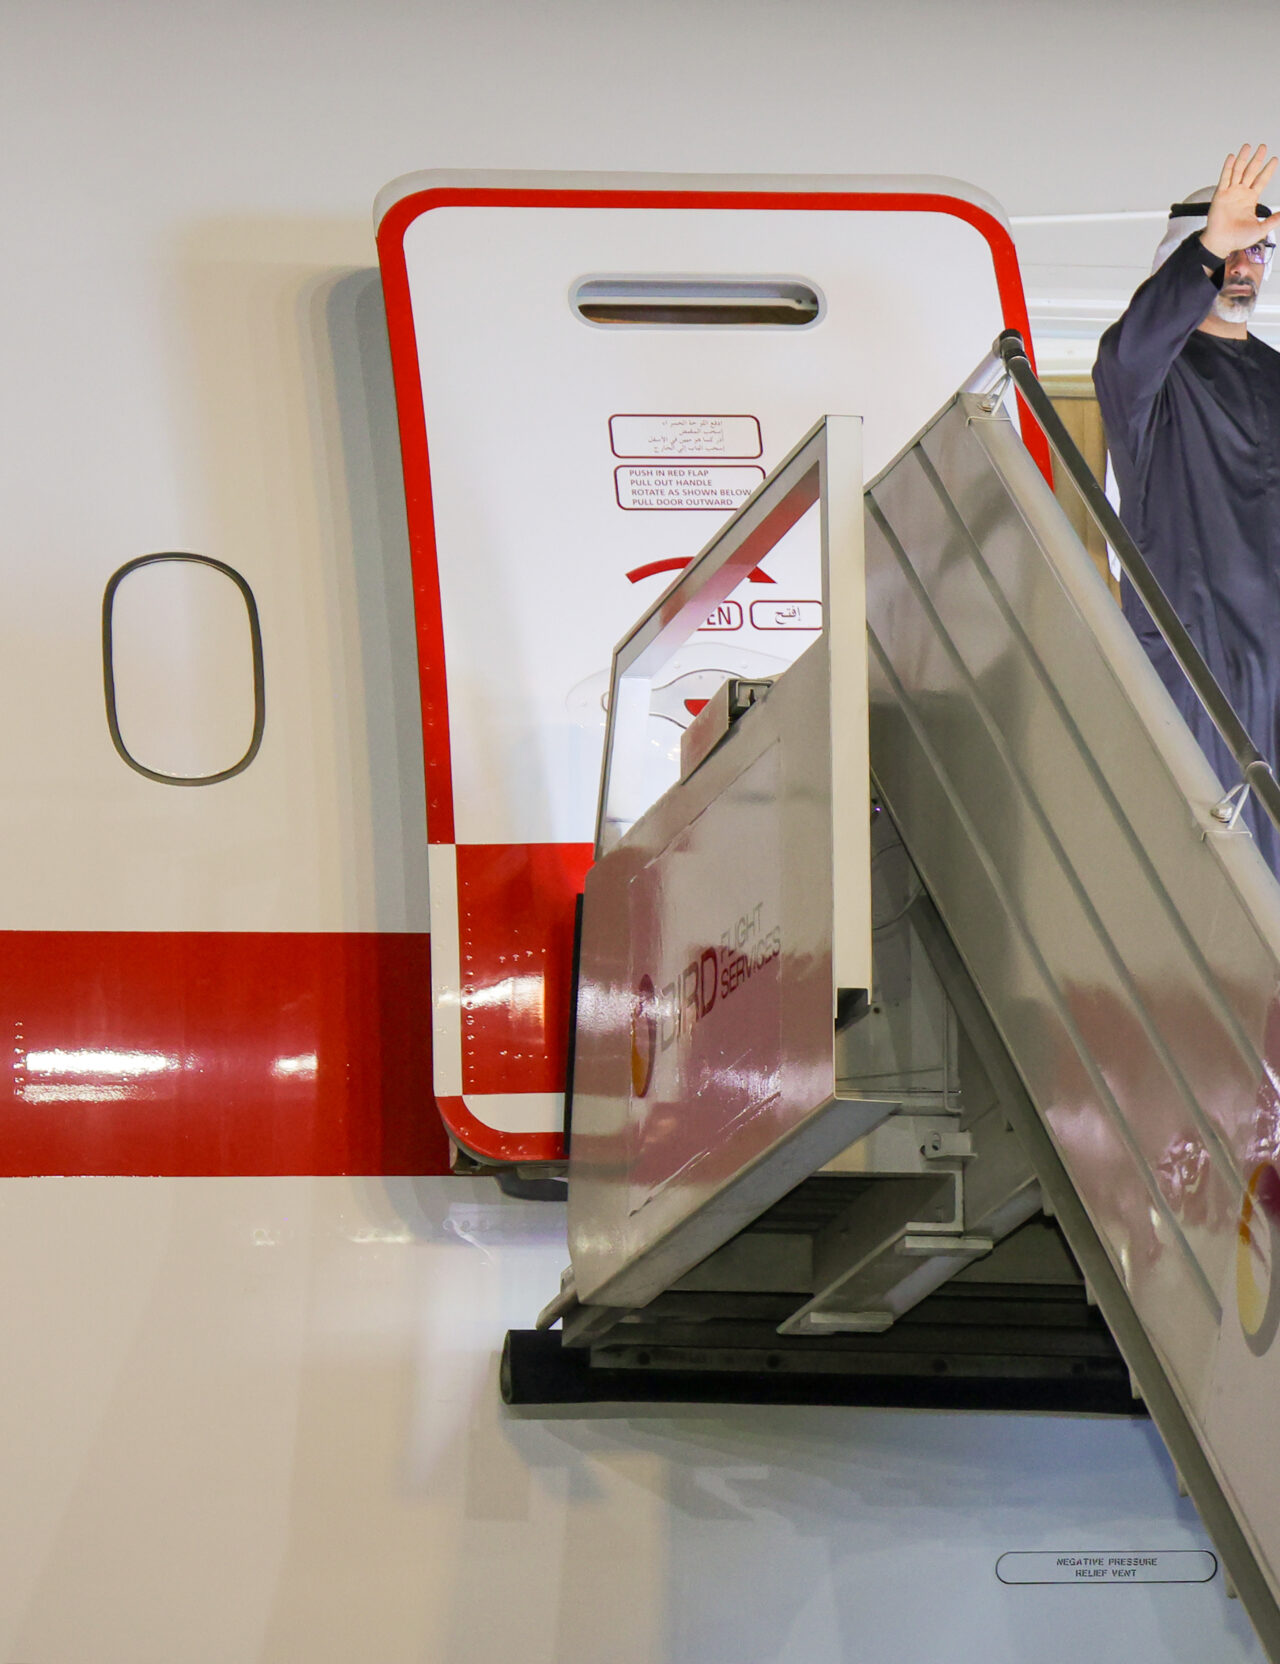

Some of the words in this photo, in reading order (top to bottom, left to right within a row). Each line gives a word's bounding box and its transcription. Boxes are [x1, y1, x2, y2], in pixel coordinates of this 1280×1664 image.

[629, 469, 653, 477] PUSH
[655, 469, 665, 477] IN
[667, 469, 685, 477] RED
[687, 469, 709, 477] FLAP
[632, 498, 654, 506] PULL
[656, 498, 683, 506] DOOR
[686, 498, 733, 506] OUTWARD
[706, 606, 732, 625] EN
[720, 902, 763, 963] FLIGHT
[720, 925, 781, 1000] SERVICES
[1056, 1557, 1105, 1566] NEGATIVE
[1108, 1557, 1158, 1566] PRESSURE
[1075, 1569, 1108, 1577] RELIEF
[1111, 1569, 1137, 1577] VENT
